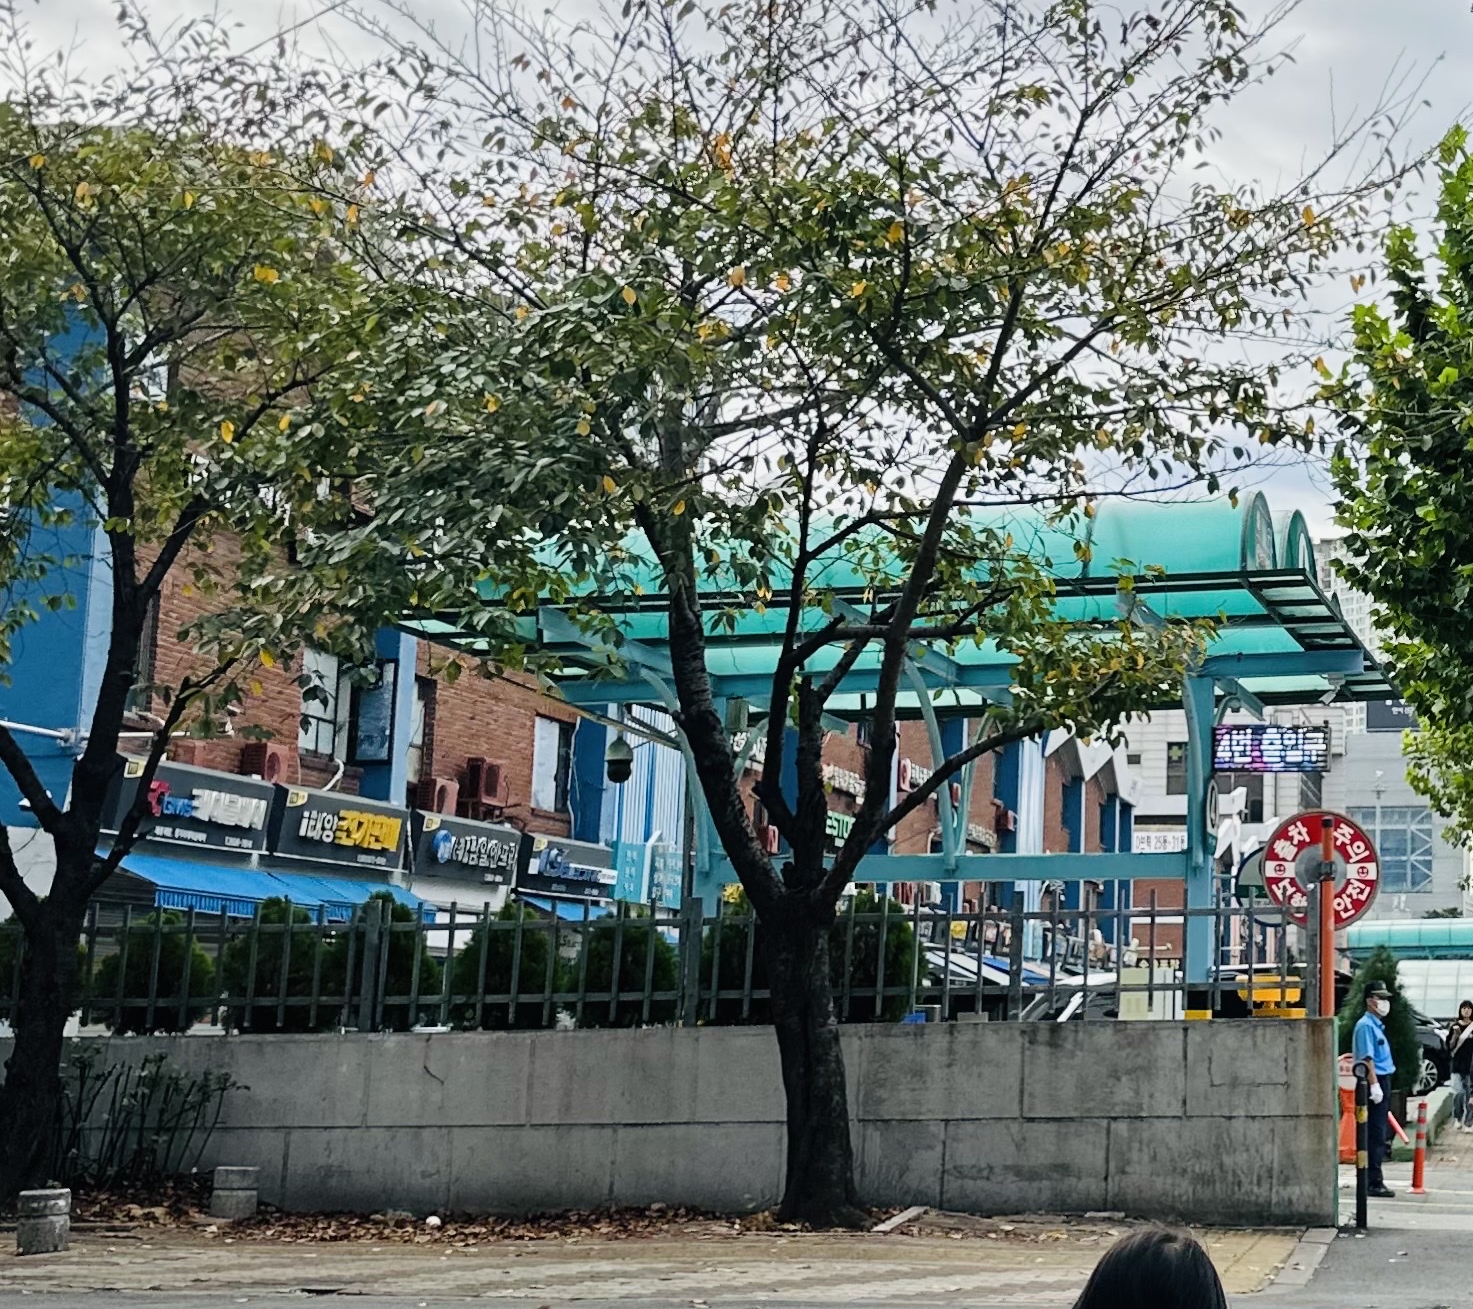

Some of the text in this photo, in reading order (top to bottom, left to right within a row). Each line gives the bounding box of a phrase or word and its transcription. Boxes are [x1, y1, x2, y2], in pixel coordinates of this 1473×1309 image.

[1273, 820, 1370, 864] 출차 주의
[1332, 878, 1371, 920] 안전
